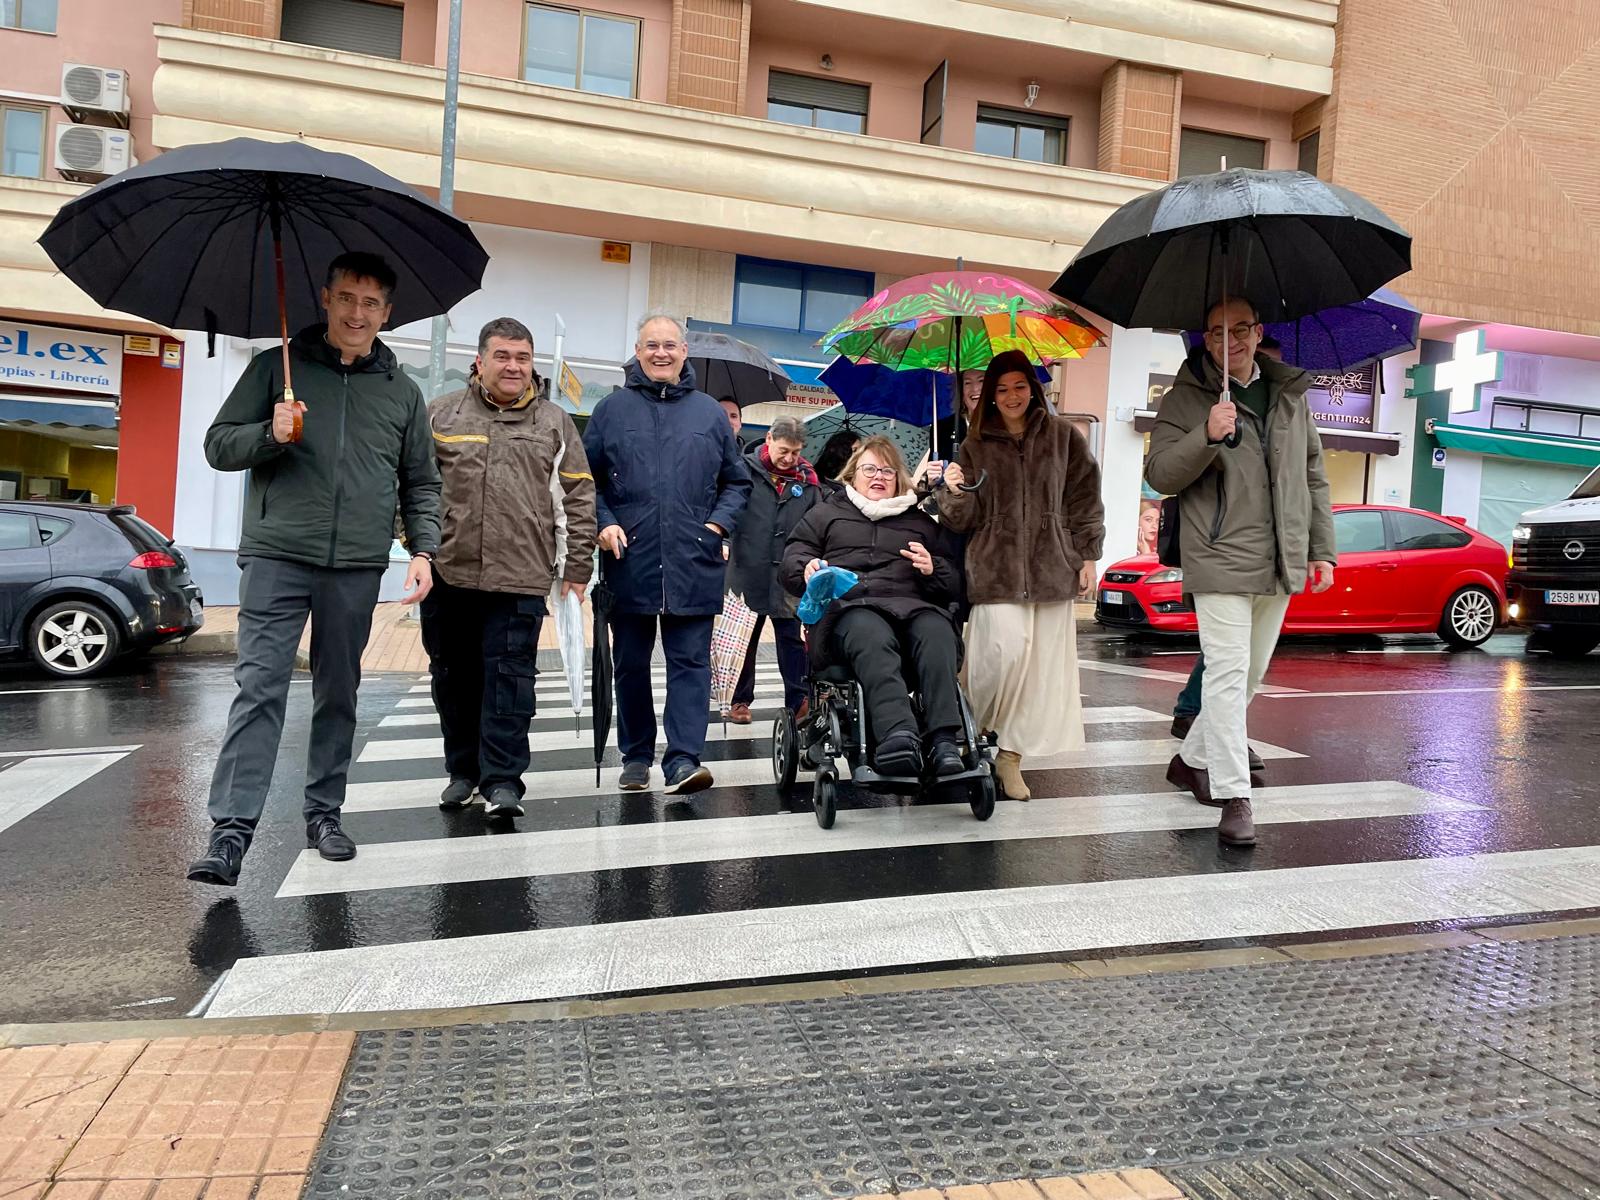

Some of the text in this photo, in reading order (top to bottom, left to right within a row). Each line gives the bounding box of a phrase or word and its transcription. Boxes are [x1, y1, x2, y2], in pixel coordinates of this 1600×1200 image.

[50, 369, 110, 386] Librería
[820, 399, 840, 407] PINT
[1311, 412, 1371, 424] GENTINA24
[1551, 592, 1597, 603] 2598 MXV
